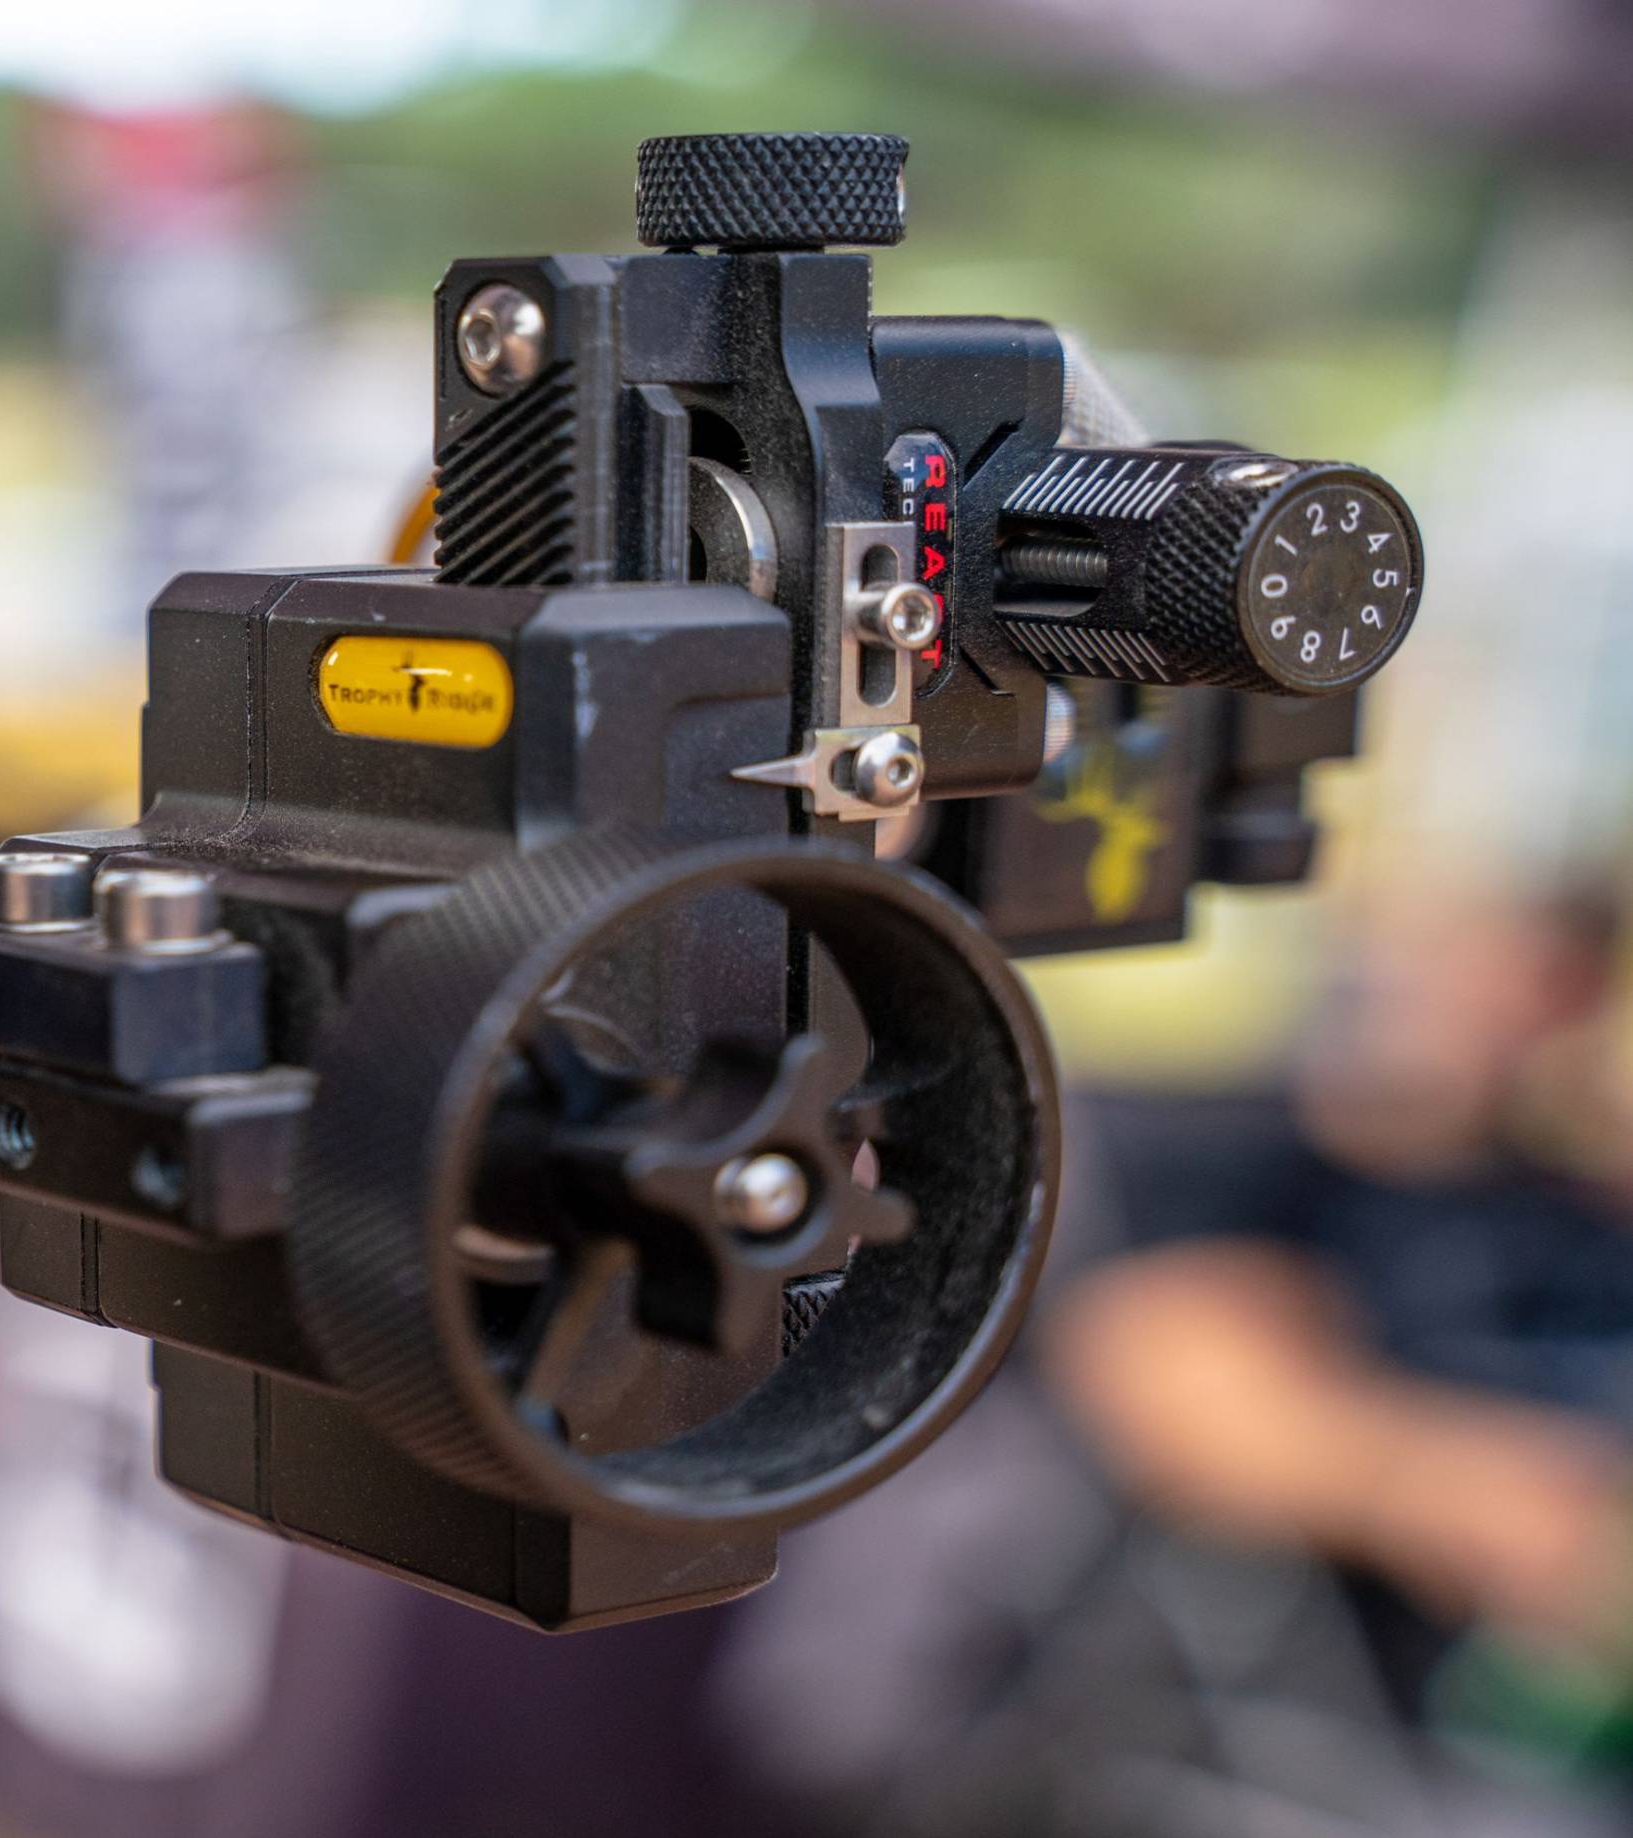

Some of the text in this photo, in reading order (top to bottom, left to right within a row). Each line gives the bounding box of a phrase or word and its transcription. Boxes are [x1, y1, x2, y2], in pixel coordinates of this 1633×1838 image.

[1306, 503, 1328, 537] 2
[1340, 501, 1360, 533] 3
[1274, 534, 1298, 557] 1
[1367, 532, 1393, 554] 4
[921, 454, 947, 669] REAT
[1261, 573, 1288, 598] 0
[1372, 569, 1400, 588] 5
[1300, 630, 1321, 663] 8
[1338, 627, 1357, 661] 7
[328, 683, 403, 706] TROPHY
